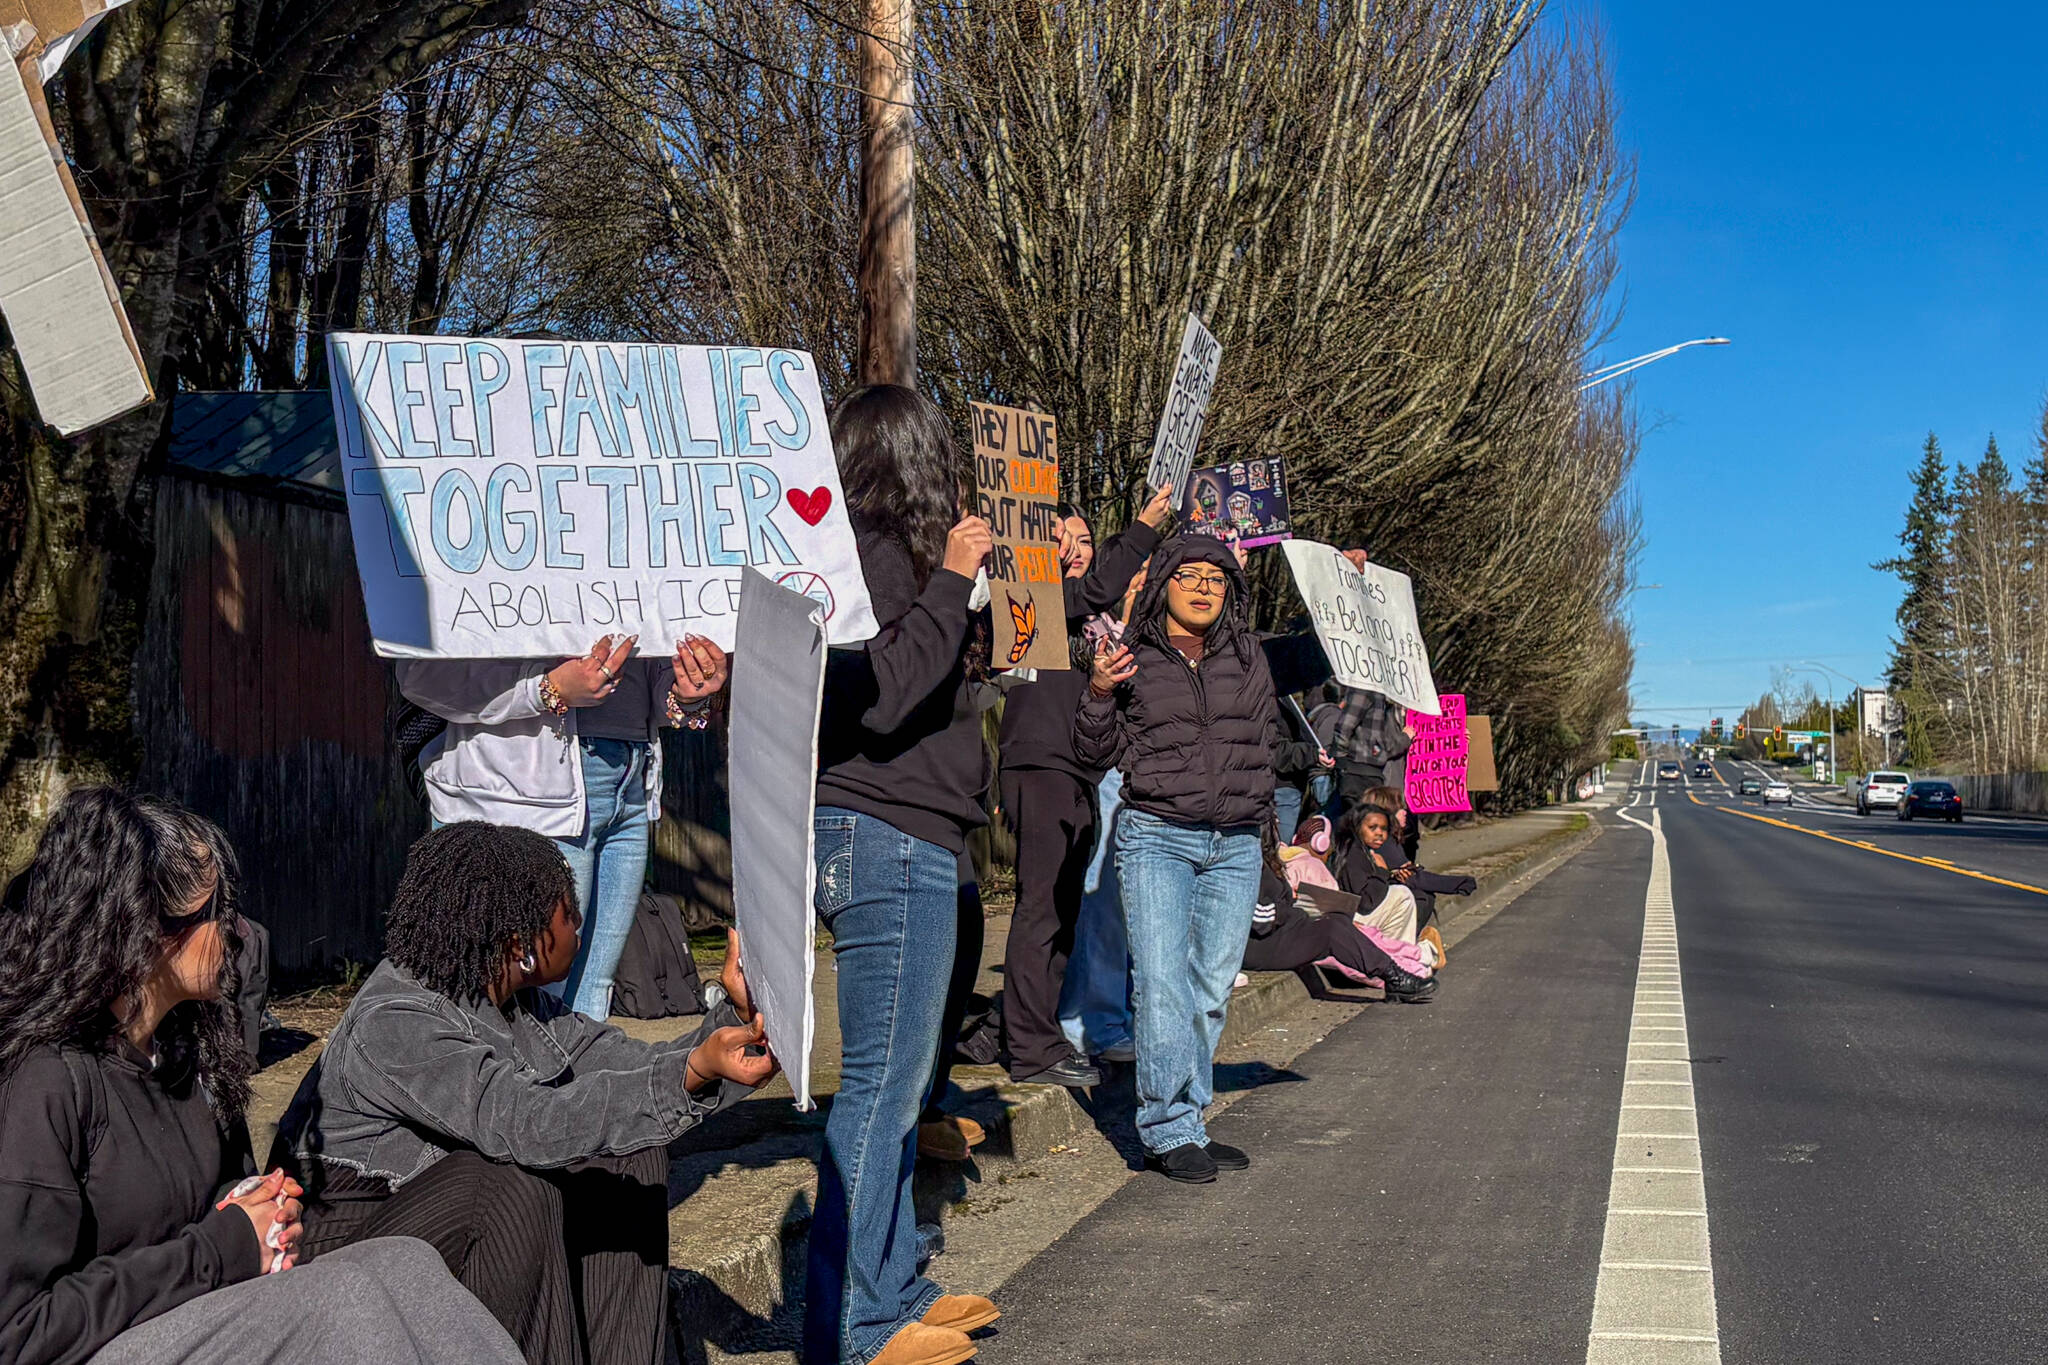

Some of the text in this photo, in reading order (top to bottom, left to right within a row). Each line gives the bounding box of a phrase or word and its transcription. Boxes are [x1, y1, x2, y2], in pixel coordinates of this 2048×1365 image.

[1190, 325, 1218, 377] MAKE
[331, 341, 811, 459] KEEP FAMILIES
[1168, 389, 1205, 460] GREAT
[972, 404, 1056, 463] THEY LOVE
[977, 454, 1008, 493] OUR
[1149, 434, 1190, 501] AGAIN
[352, 462, 801, 577] TOGETHER
[978, 493, 1059, 543] BUT HATE
[983, 543, 1016, 582] OUR
[451, 578, 741, 632] ABOLISH ICE
[1337, 595, 1397, 659] Belong
[1410, 758, 1430, 775] WAY
[1431, 757, 1442, 772] OF
[1425, 738, 1435, 753] IN
[1436, 735, 1460, 752] THE
